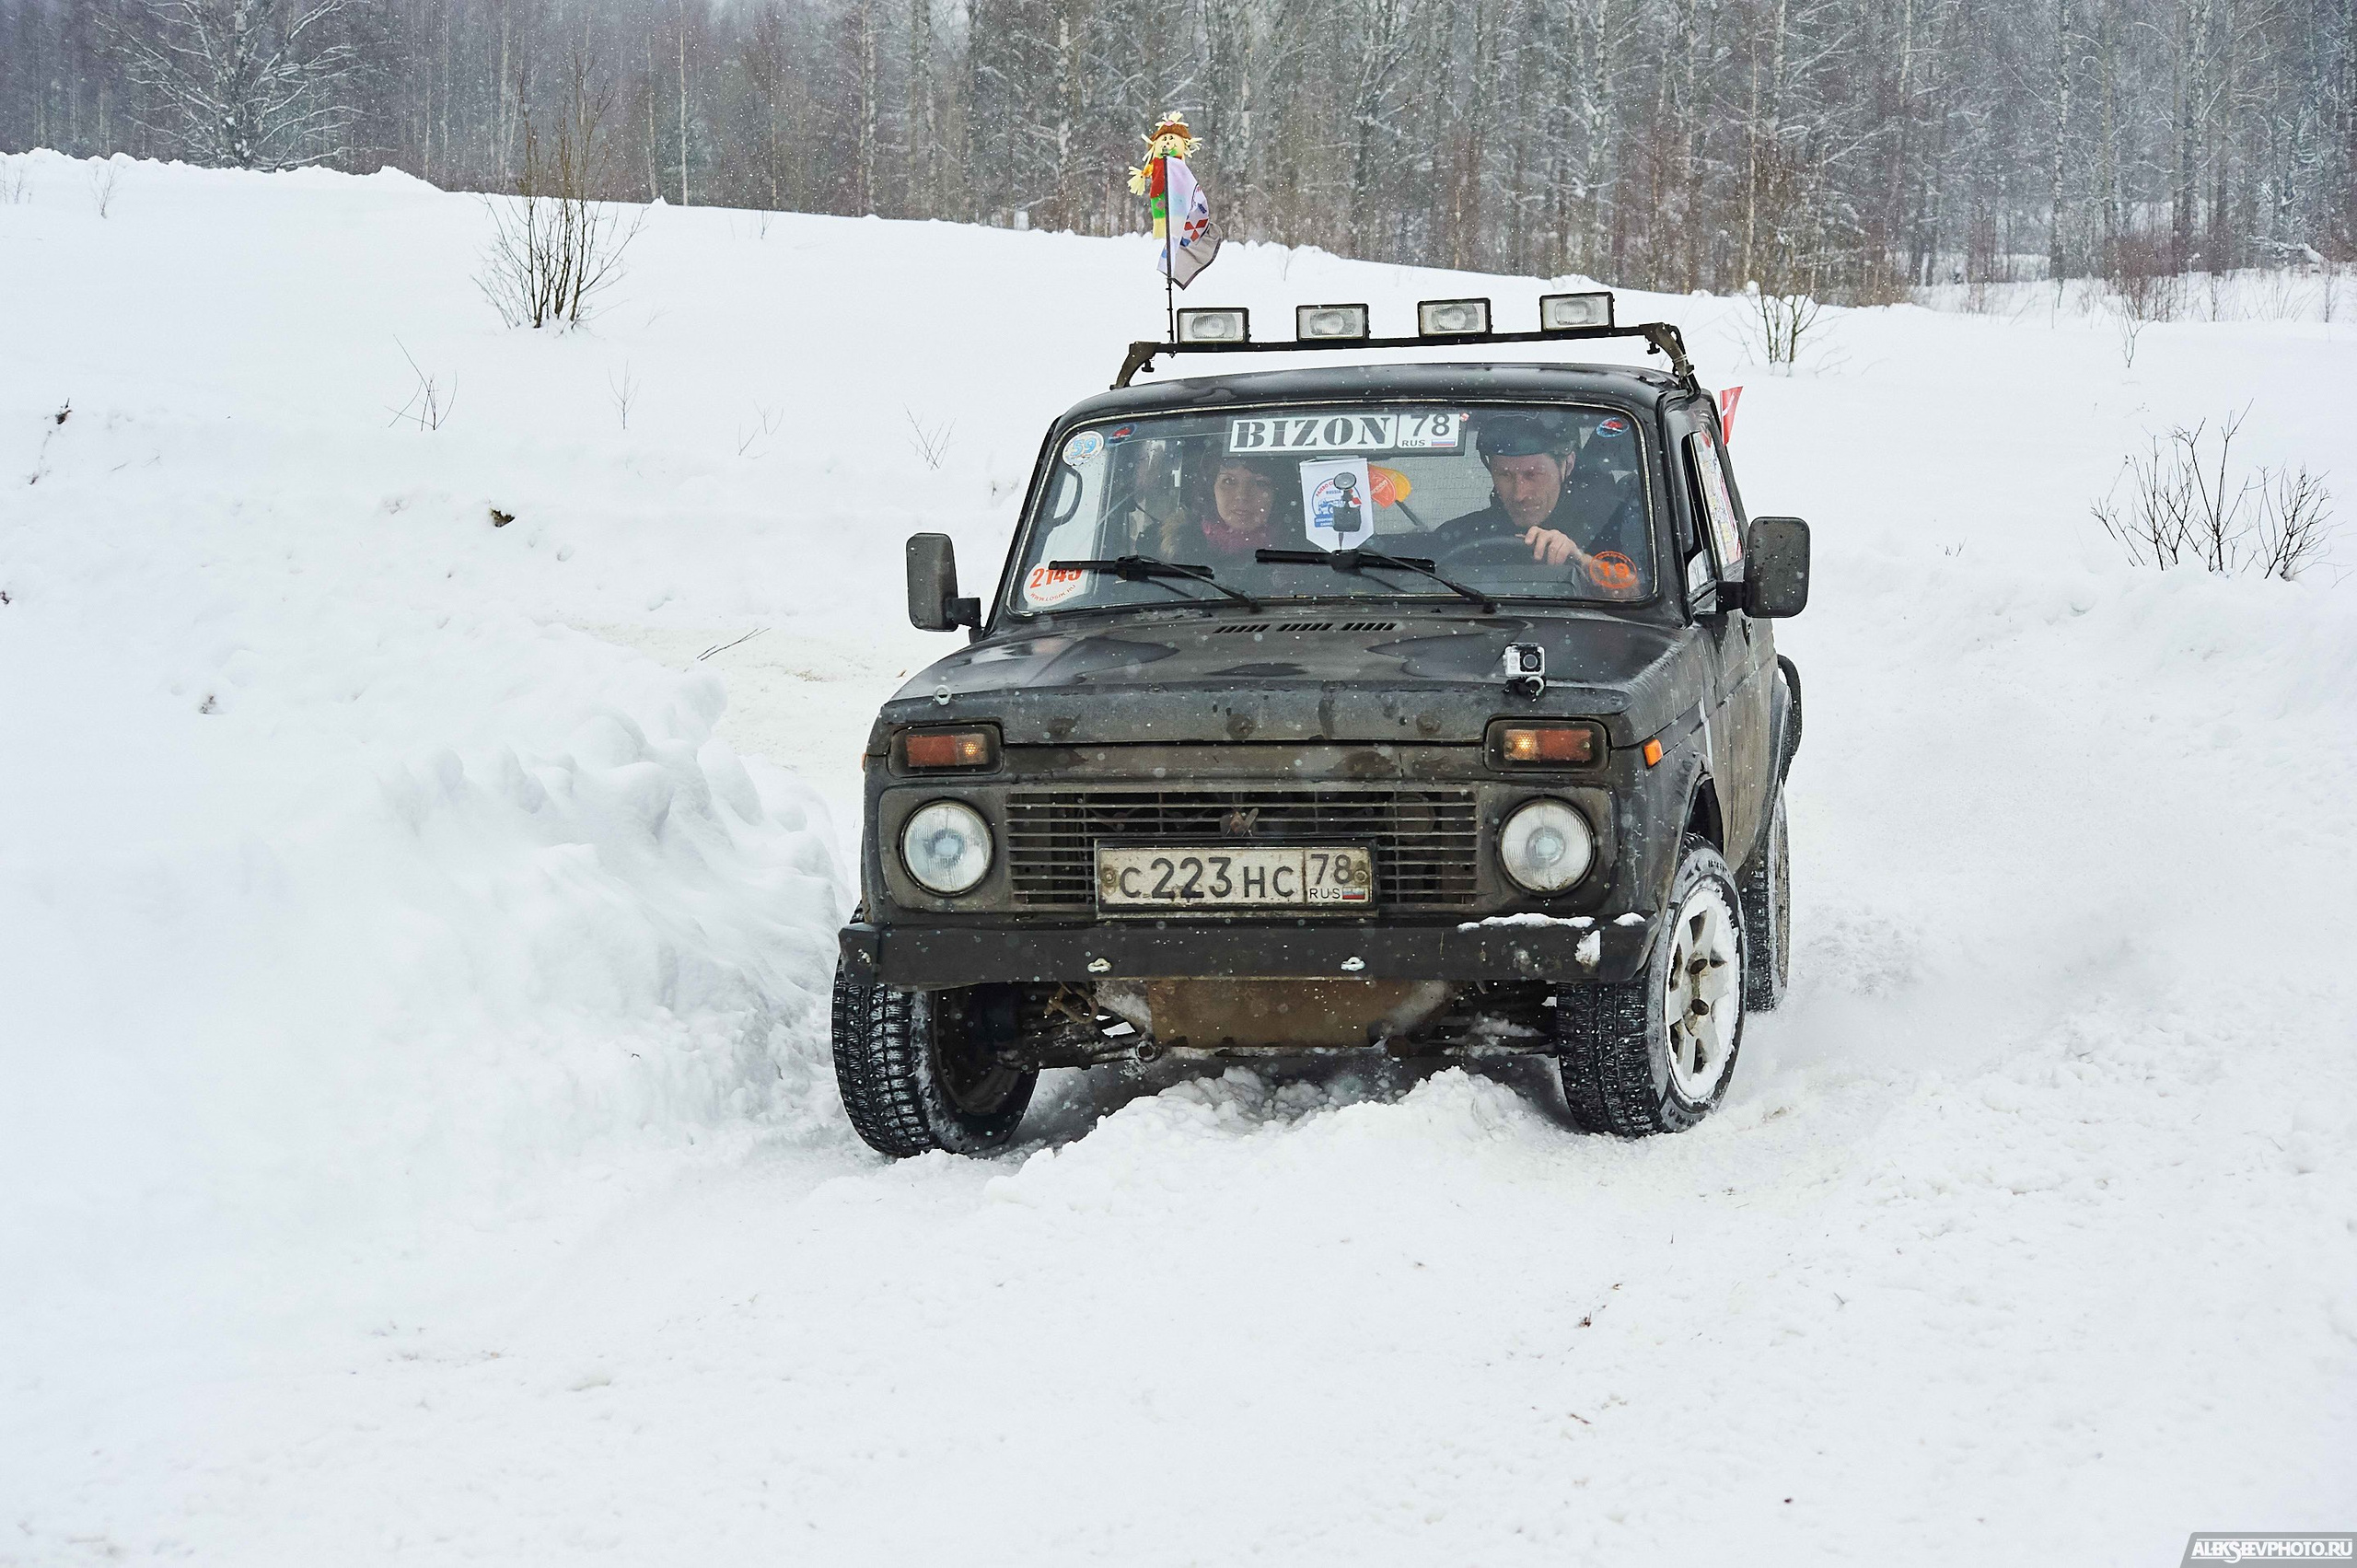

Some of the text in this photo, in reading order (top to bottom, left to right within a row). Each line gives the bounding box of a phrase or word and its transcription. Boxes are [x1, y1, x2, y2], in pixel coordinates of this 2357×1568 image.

[1234, 416, 1390, 448] BIZON
[1411, 413, 1450, 437] 78
[1071, 437, 1097, 457] 59
[1310, 854, 1353, 885] 78
[1309, 888, 1341, 900] RUS
